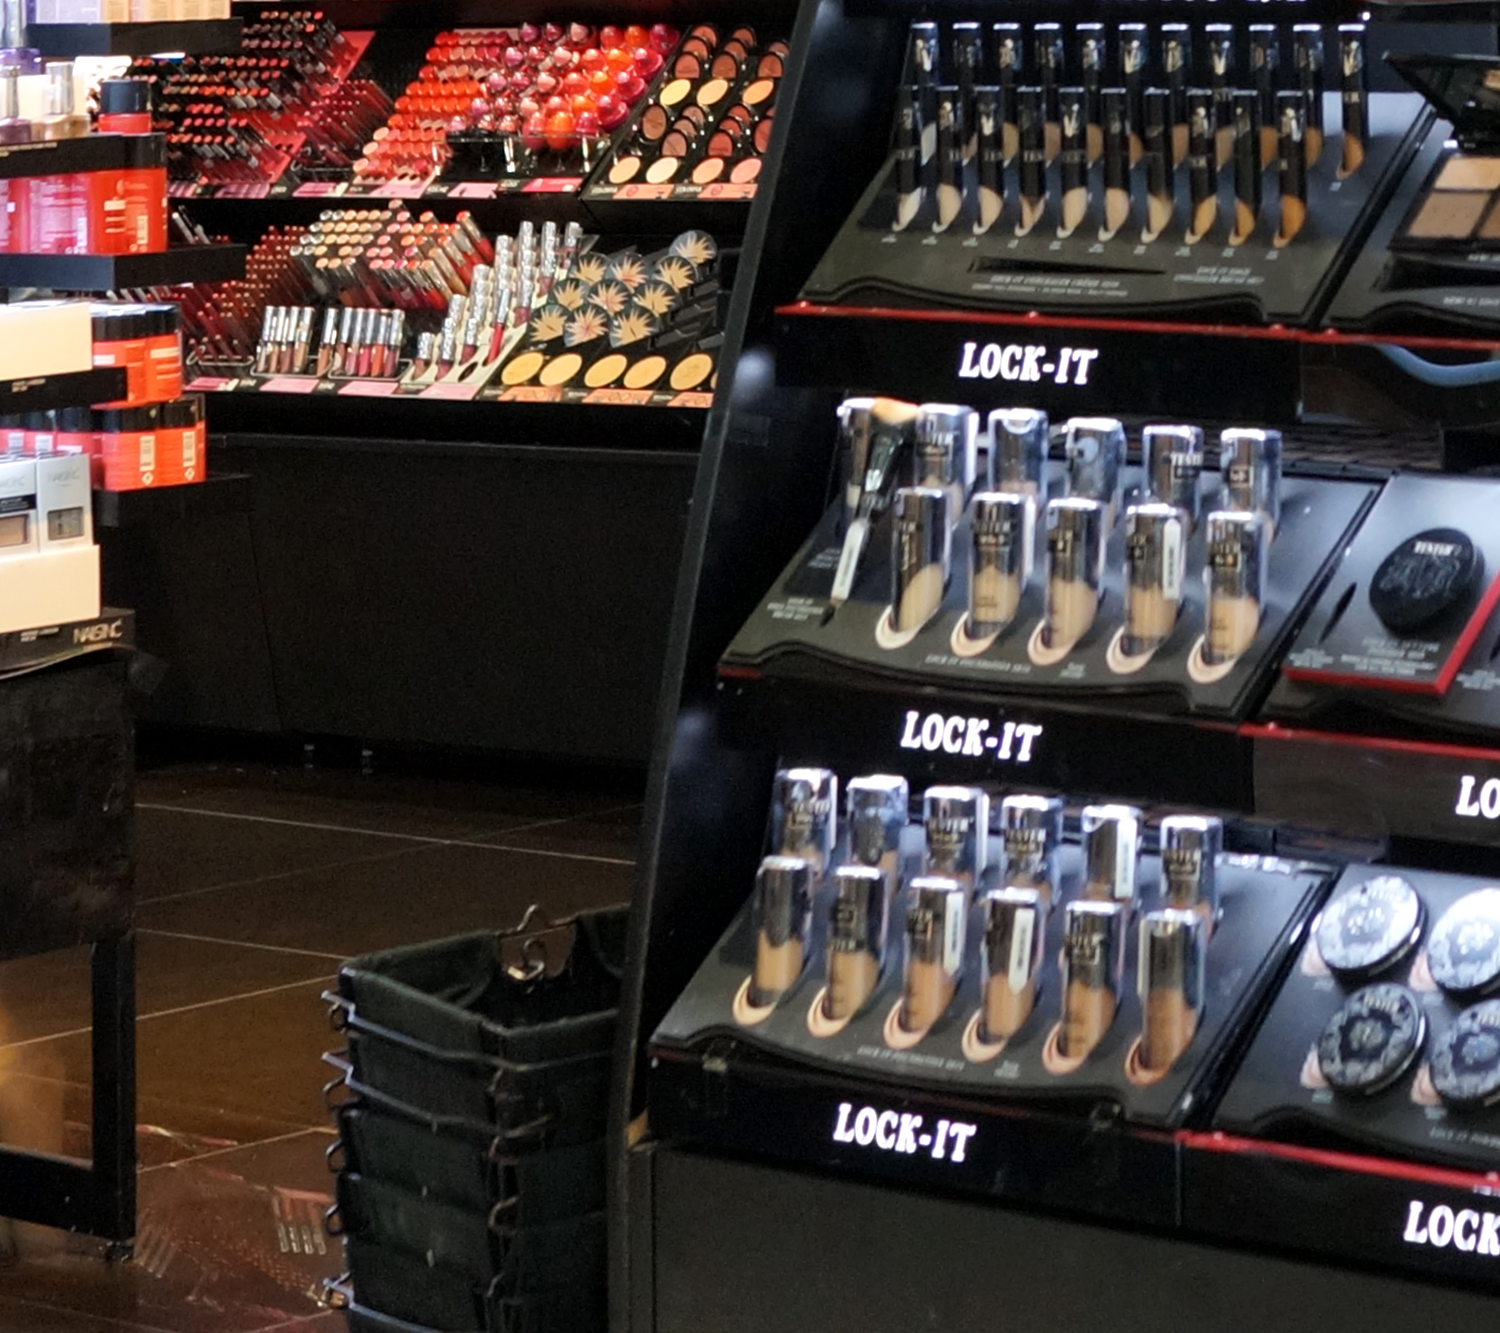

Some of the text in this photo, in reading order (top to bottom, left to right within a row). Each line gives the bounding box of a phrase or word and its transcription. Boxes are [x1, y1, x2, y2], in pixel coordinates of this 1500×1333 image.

[958, 341, 1098, 386] LOCK-IT
[900, 710, 1043, 763] LOCK-IT
[832, 1101, 978, 1164] LOCK-IT
